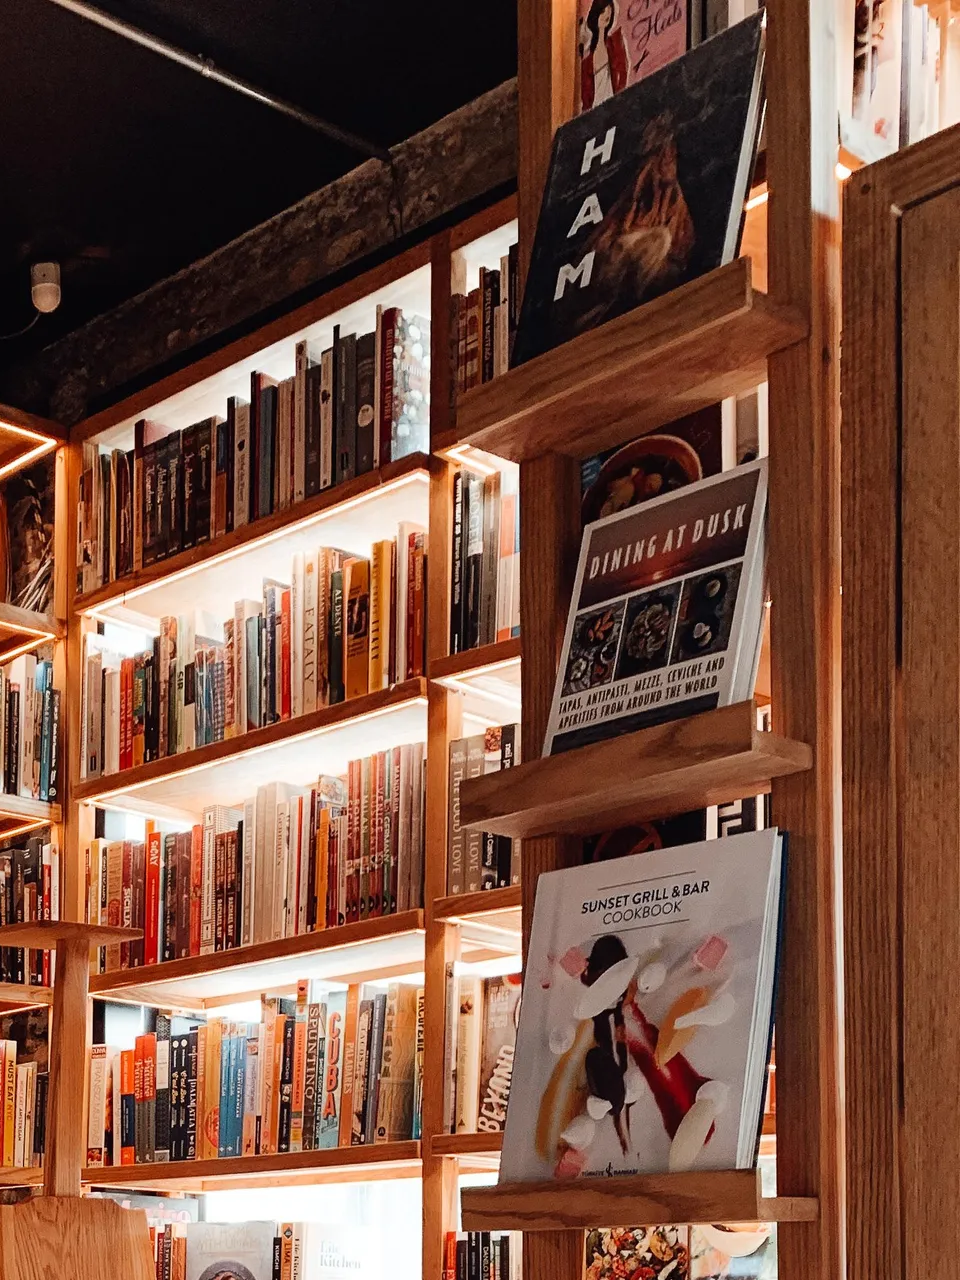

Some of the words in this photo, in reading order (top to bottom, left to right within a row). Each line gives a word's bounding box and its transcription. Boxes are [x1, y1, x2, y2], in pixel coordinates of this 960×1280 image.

[553, 125, 617, 302] HAM
[589, 535, 657, 581] DINING
[662, 524, 688, 554] AT
[692, 504, 746, 543] DUSK
[334, 589, 342, 603] AL
[334, 604, 342, 637] DENTE
[371, 620, 379, 661] ITALY
[304, 607, 315, 685] EATALY
[558, 697, 584, 715] TAPAS,
[586, 683, 631, 706] ANTIPASTI,
[635, 673, 664, 692] MEZZE,
[667, 662, 704, 684] CEVICHE
[705, 656, 725, 674] AND
[558, 705, 599, 730] APERITIFS
[599, 701, 624, 720] FROM
[626, 688, 662, 713] AROUND
[666, 684, 682, 700] THE
[684, 675, 718, 695] WORLD
[150, 840, 158, 866] SICILY
[452, 844, 462, 874] LOVE
[469, 842, 478, 871] LOVE
[123, 887, 131, 928] SICILIA
[581, 895, 630, 915] SUNSET
[632, 887, 668, 905] GRILL
[671, 884, 681, 897] &
[682, 879, 710, 895] BAR
[602, 899, 683, 925] COOKBOOK
[305, 1007, 318, 1100] SPUNTINO
[322, 1011, 341, 1120] CUBA
[343, 1042, 354, 1095] PALADARES
[319, 1254, 362, 1271] Kitchen
